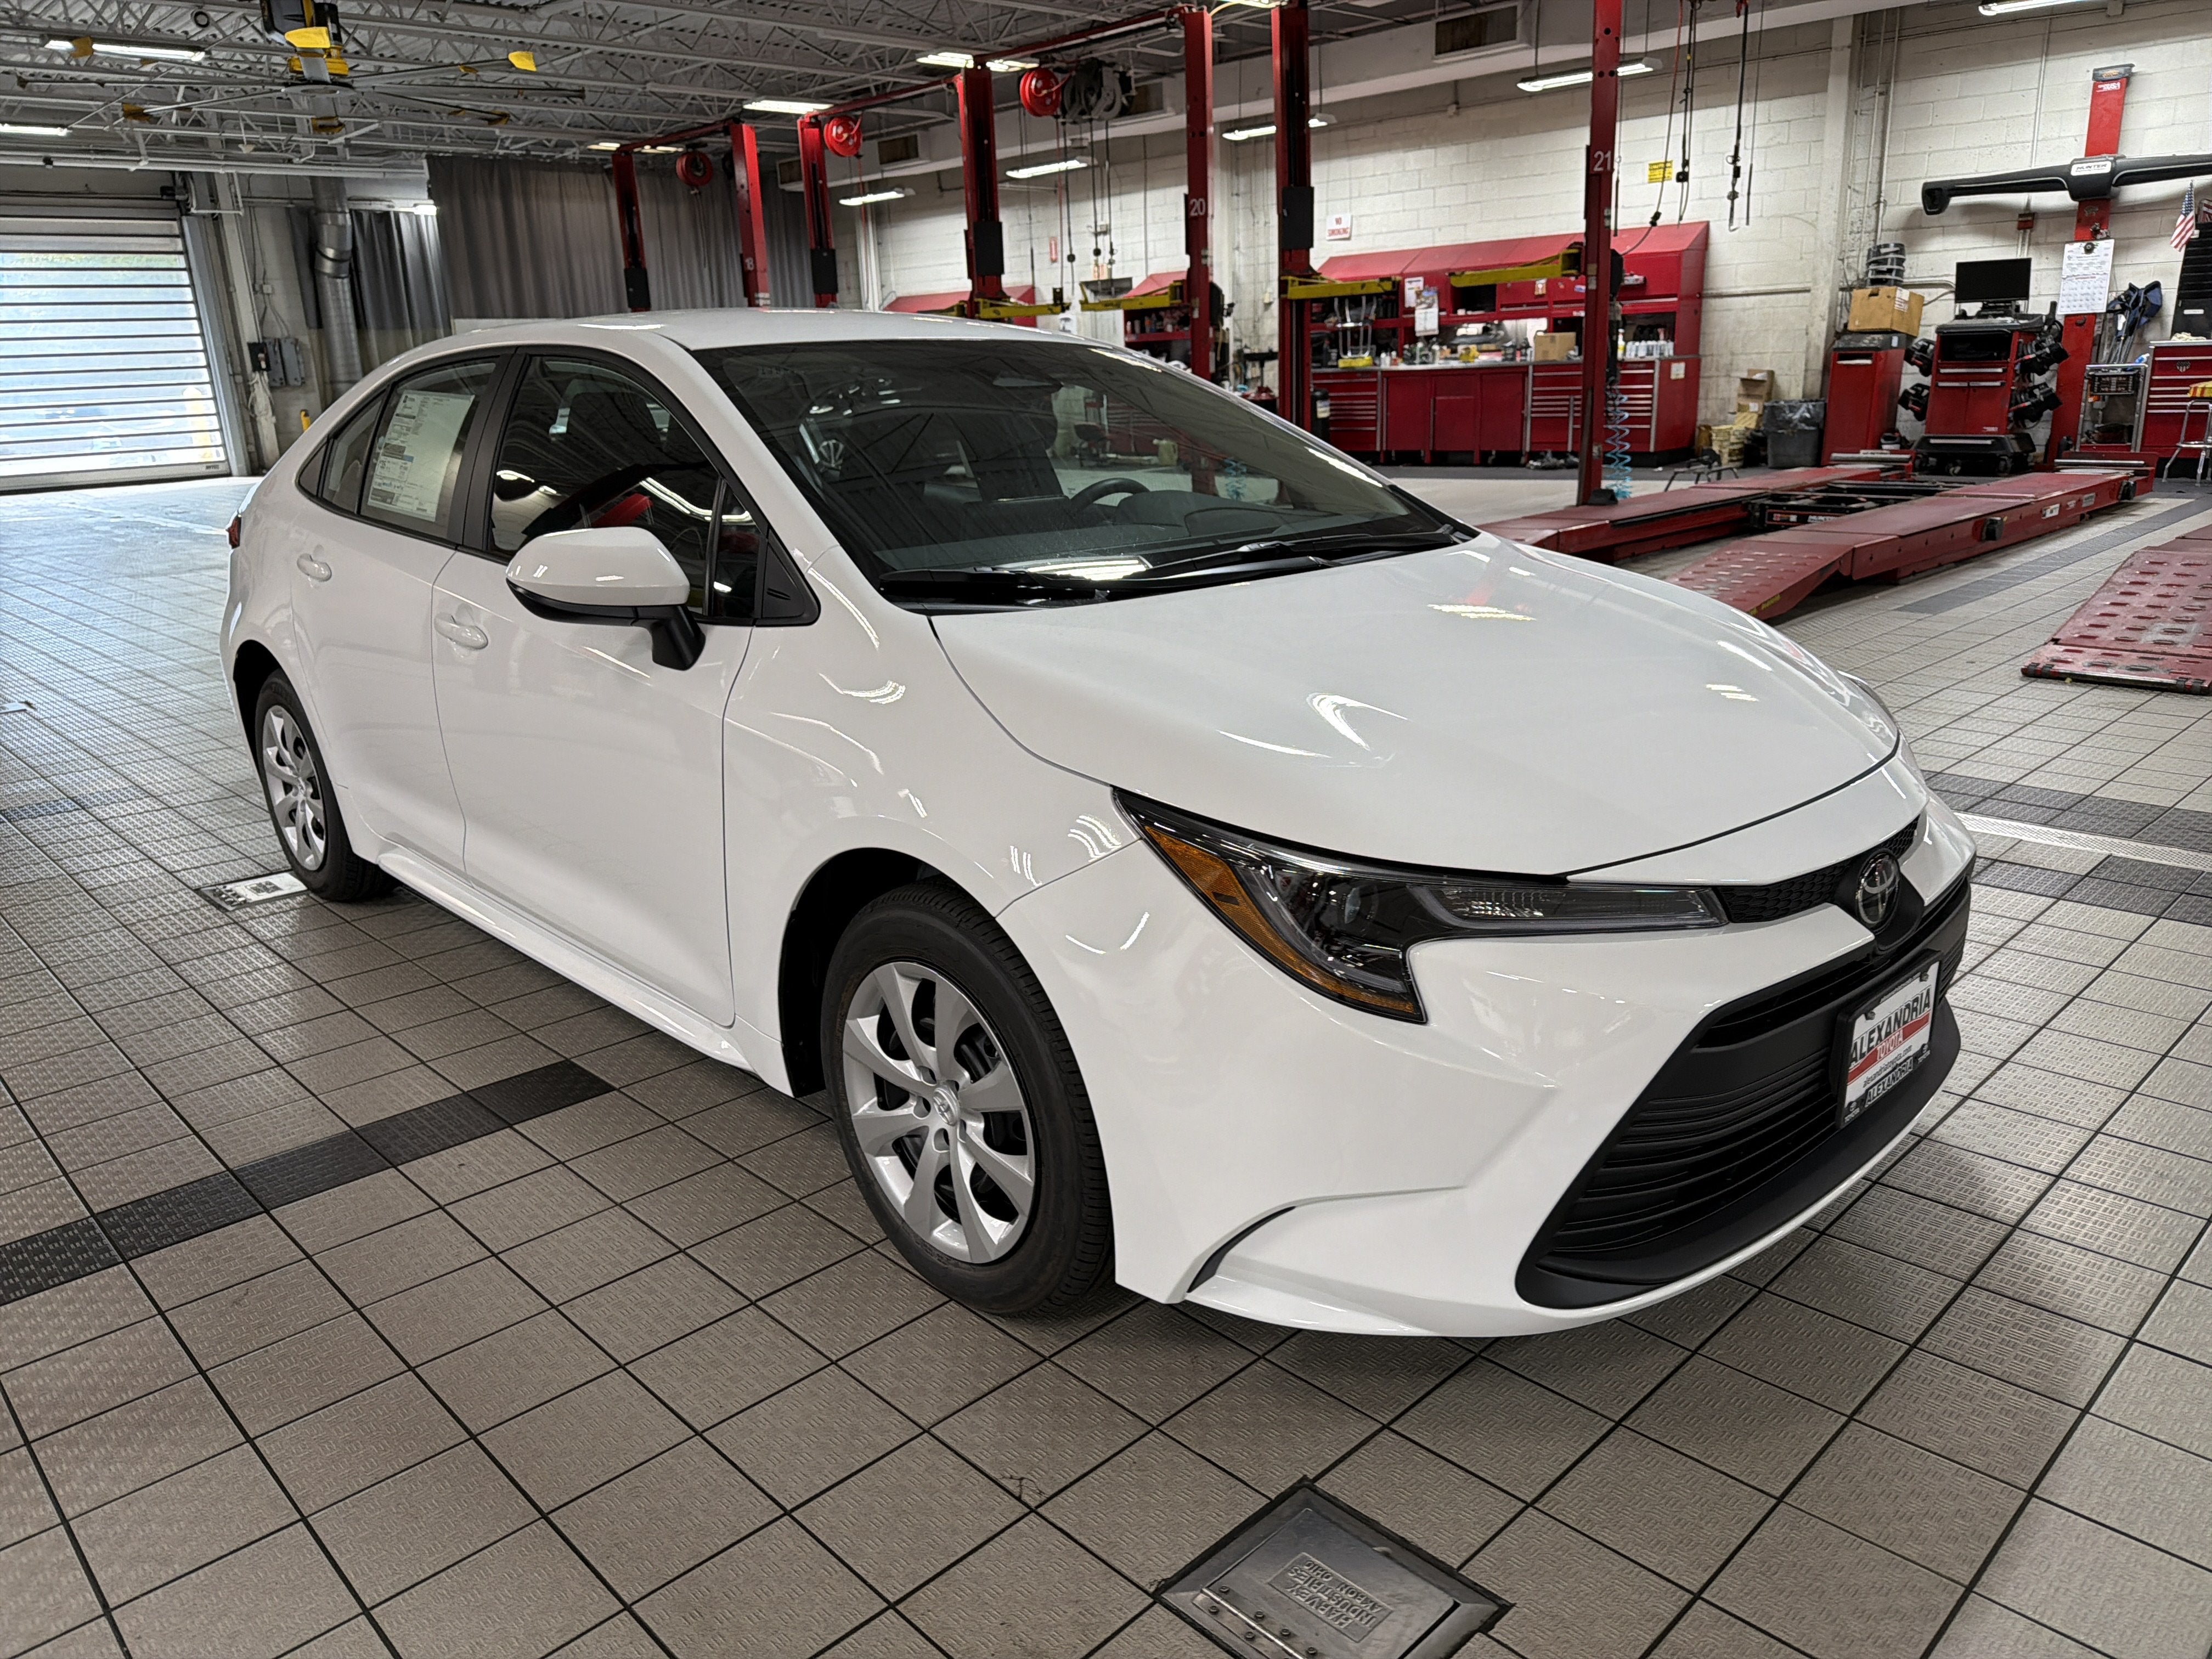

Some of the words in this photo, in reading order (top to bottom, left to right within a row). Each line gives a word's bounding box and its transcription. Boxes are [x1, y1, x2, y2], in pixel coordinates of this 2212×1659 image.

[1593, 150, 1612, 171] 21
[1190, 198, 1206, 216] 20
[1850, 988, 1930, 1063] ALEXANDRIA
[1877, 1029, 1903, 1060] TOYOTA
[1865, 1056, 1914, 1108] ALEXANDRIA
[1304, 1560, 1333, 1582] OHIO
[1286, 1583, 1355, 1628] HARVEY
[1288, 1566, 1377, 1627] INDUSTRIES
[1336, 1582, 1383, 1613] AKRON
